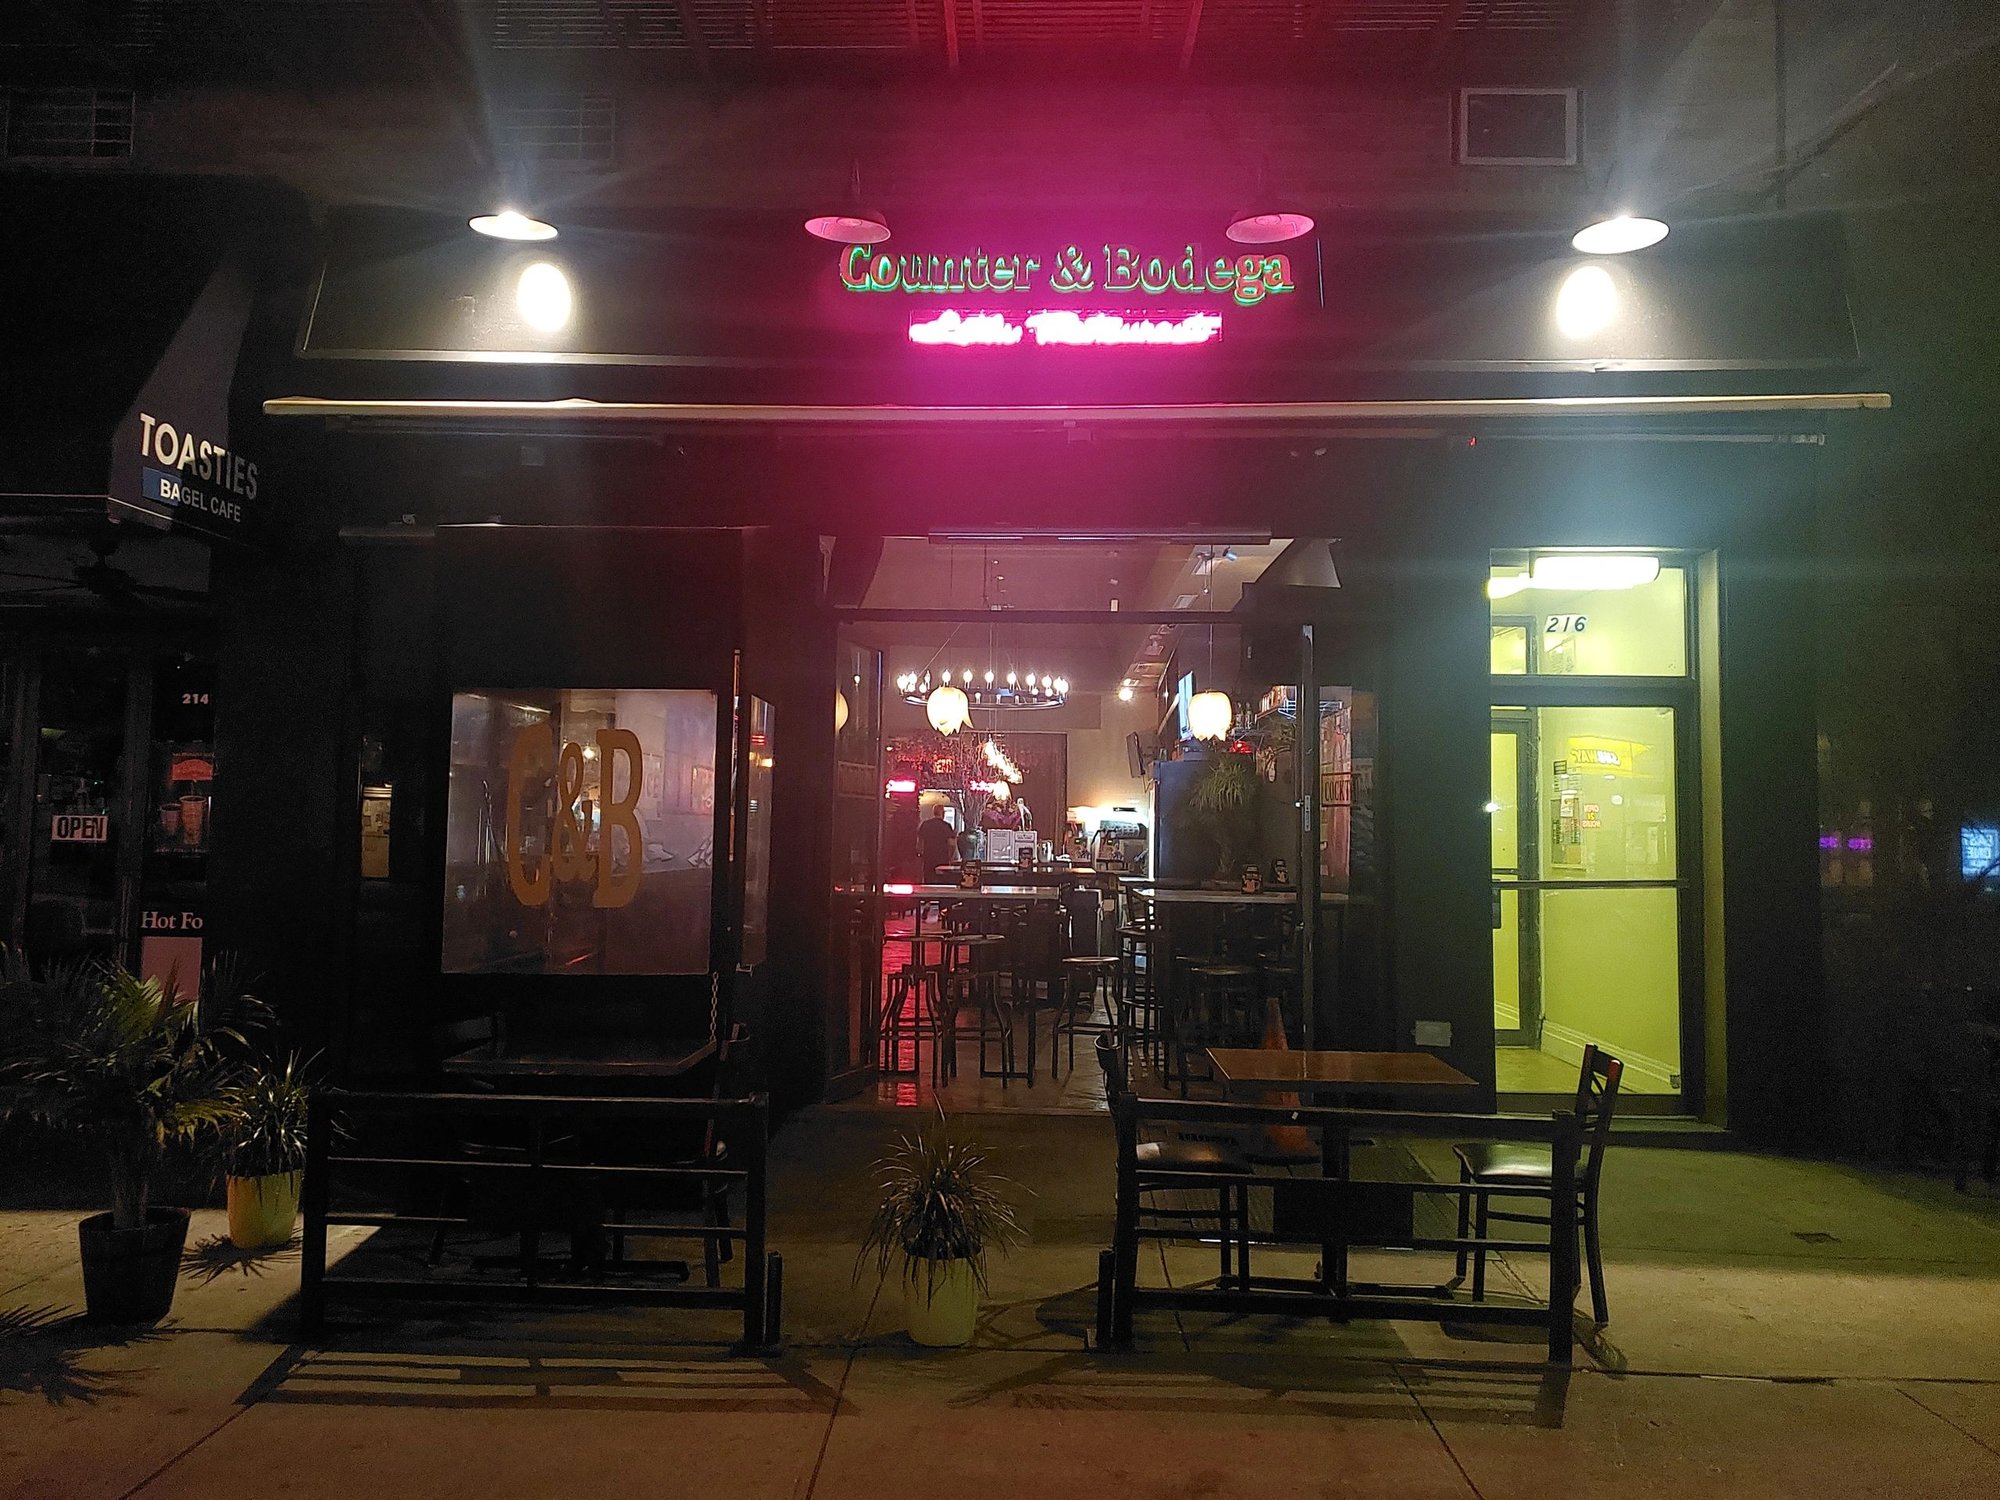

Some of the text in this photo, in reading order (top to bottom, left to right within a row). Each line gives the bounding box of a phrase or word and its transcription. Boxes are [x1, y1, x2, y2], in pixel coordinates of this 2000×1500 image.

[839, 242, 1294, 306] Counter & Bodega
[139, 411, 259, 500] TOASTIES
[160, 478, 241, 522] BAGEL CAFE
[1546, 616, 1587, 633] 216
[181, 692, 209, 705] 214
[57, 816, 103, 839] OPEN
[507, 722, 643, 908] C&B
[140, 911, 204, 931] Hot Fo
